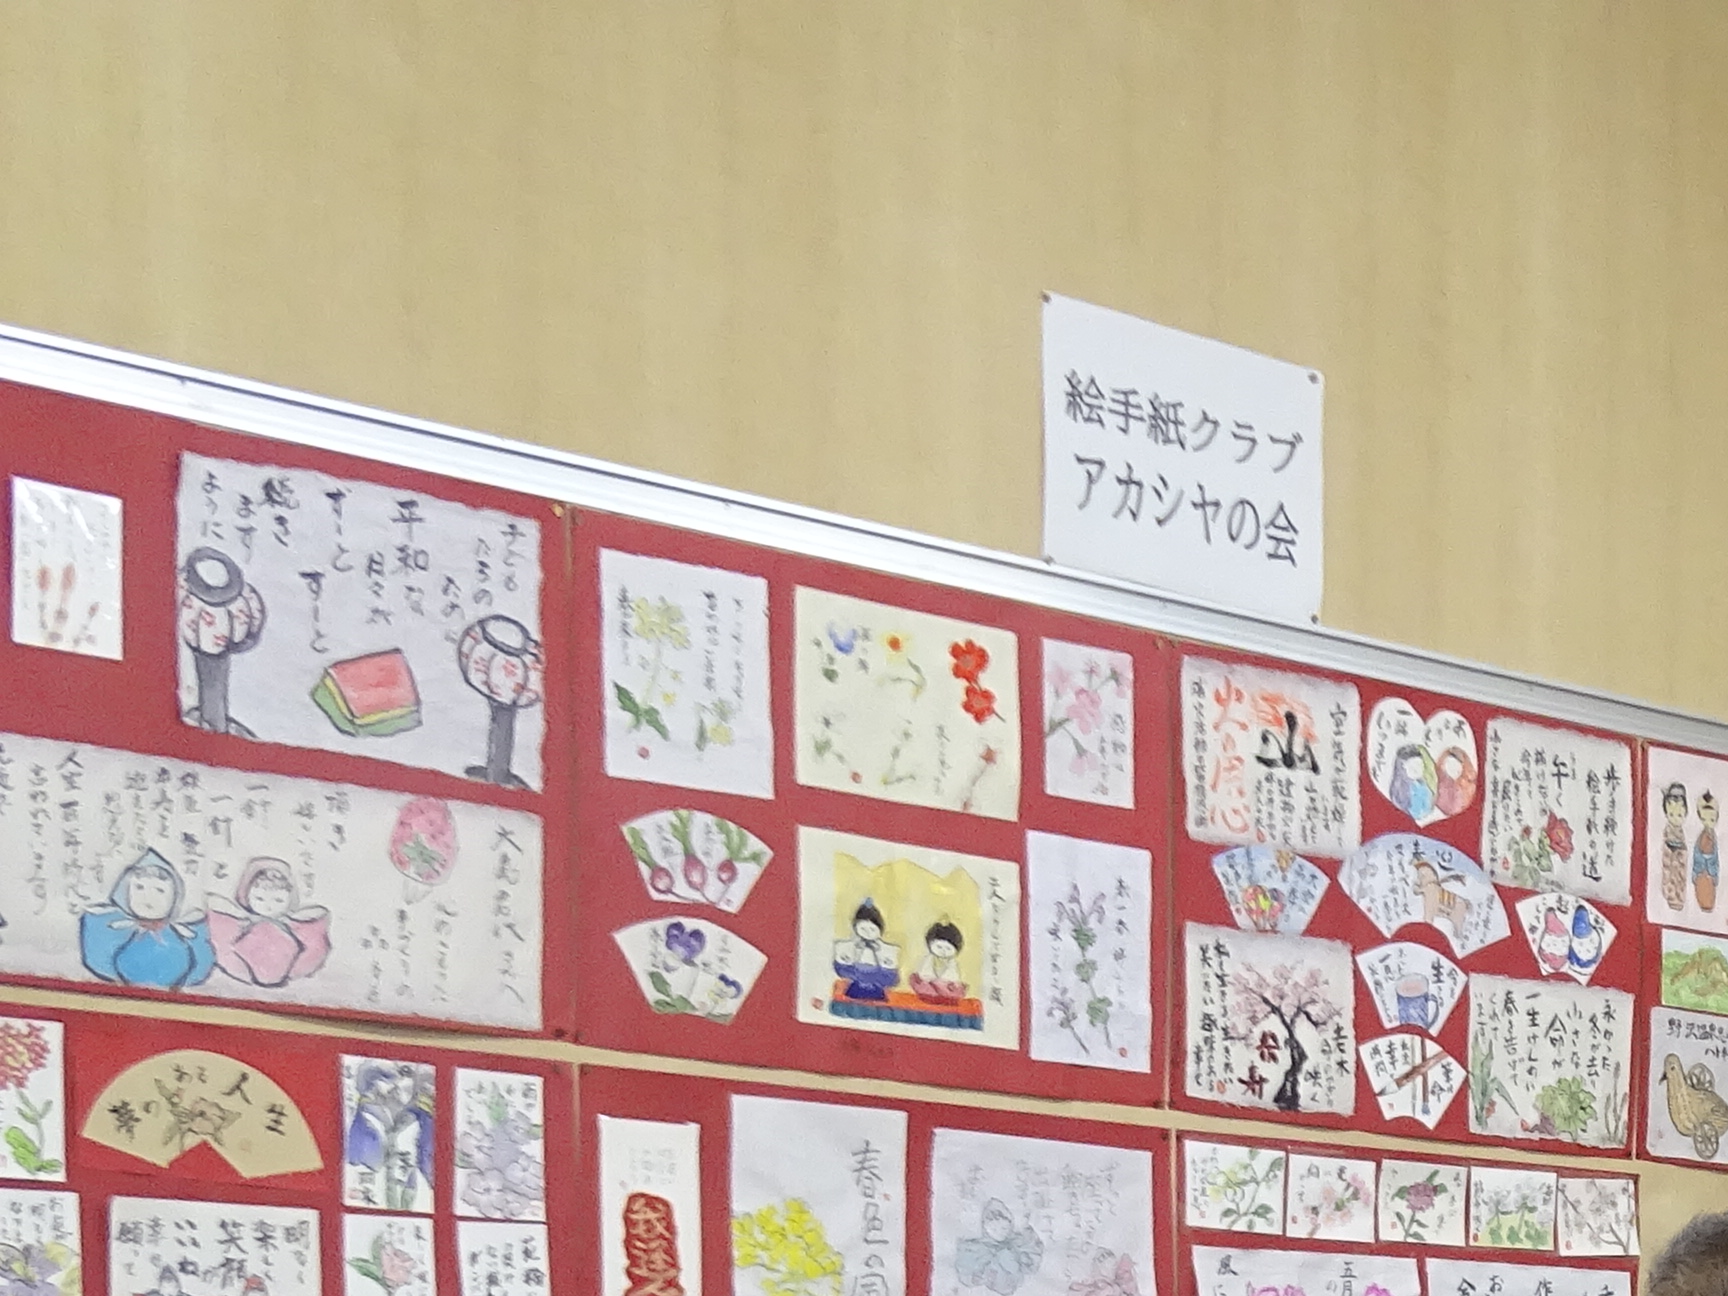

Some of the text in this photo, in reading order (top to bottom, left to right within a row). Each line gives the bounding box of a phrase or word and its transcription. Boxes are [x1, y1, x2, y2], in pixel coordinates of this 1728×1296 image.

[1064, 369, 1303, 473] 絵手紙クラブ
[1074, 453, 1298, 567] アカシヤの会
